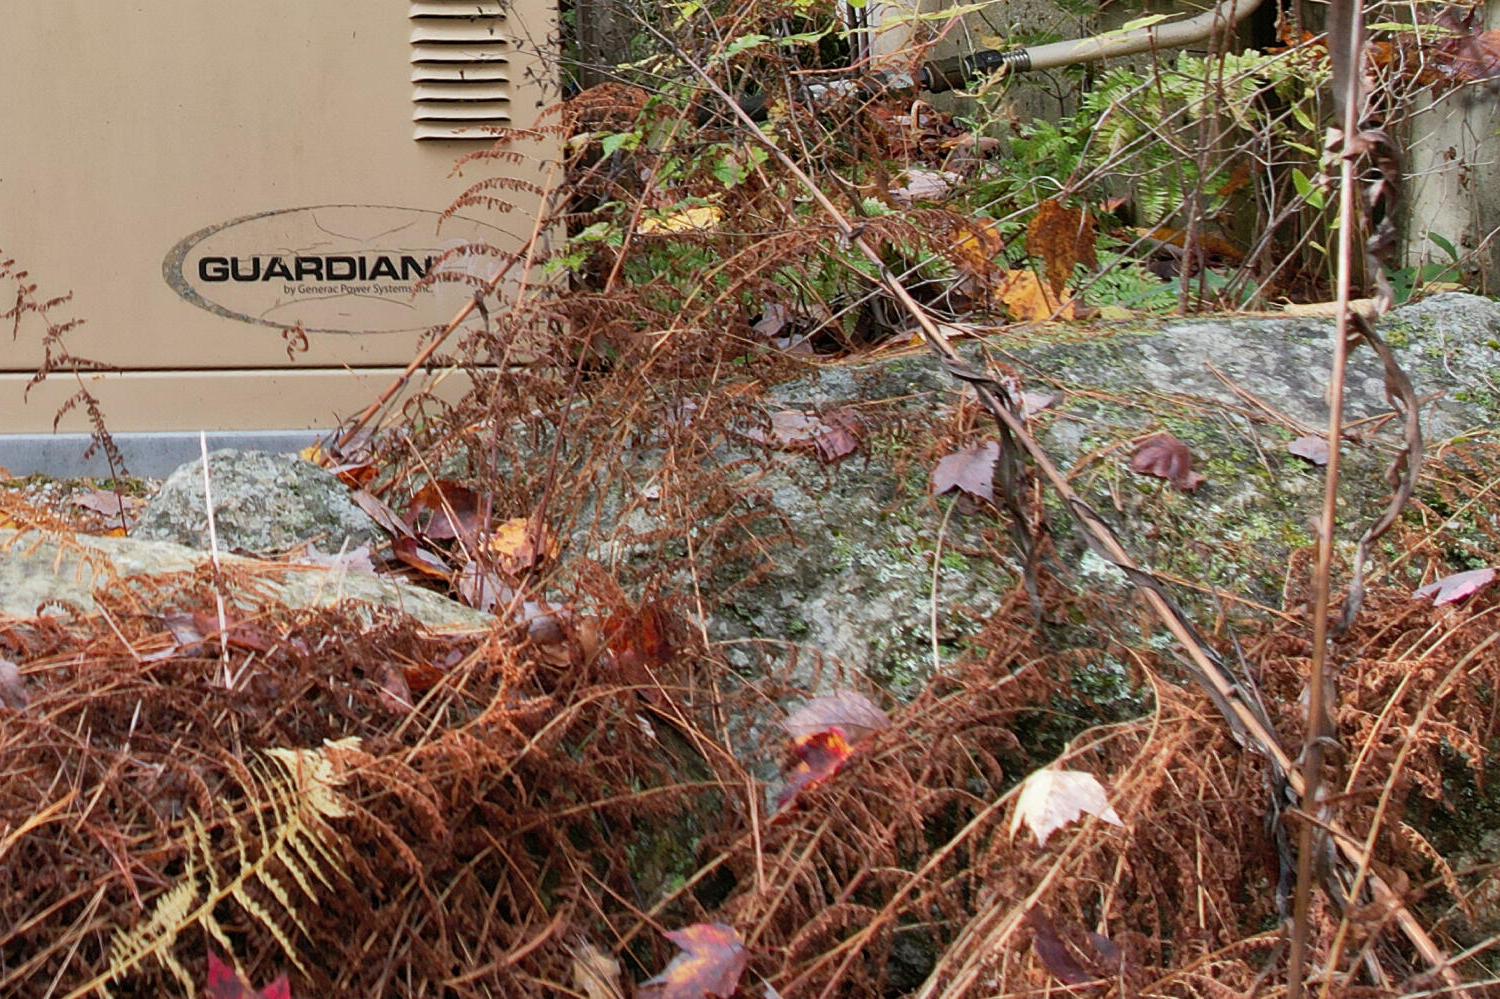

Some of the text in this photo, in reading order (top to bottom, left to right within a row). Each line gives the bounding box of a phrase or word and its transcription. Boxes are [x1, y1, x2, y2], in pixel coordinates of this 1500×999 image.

[199, 256, 432, 281] GUARDIAN
[284, 284, 296, 296] by
[298, 284, 338, 294] Generac
[340, 284, 371, 294] Power
[373, 284, 412, 296] Systems
